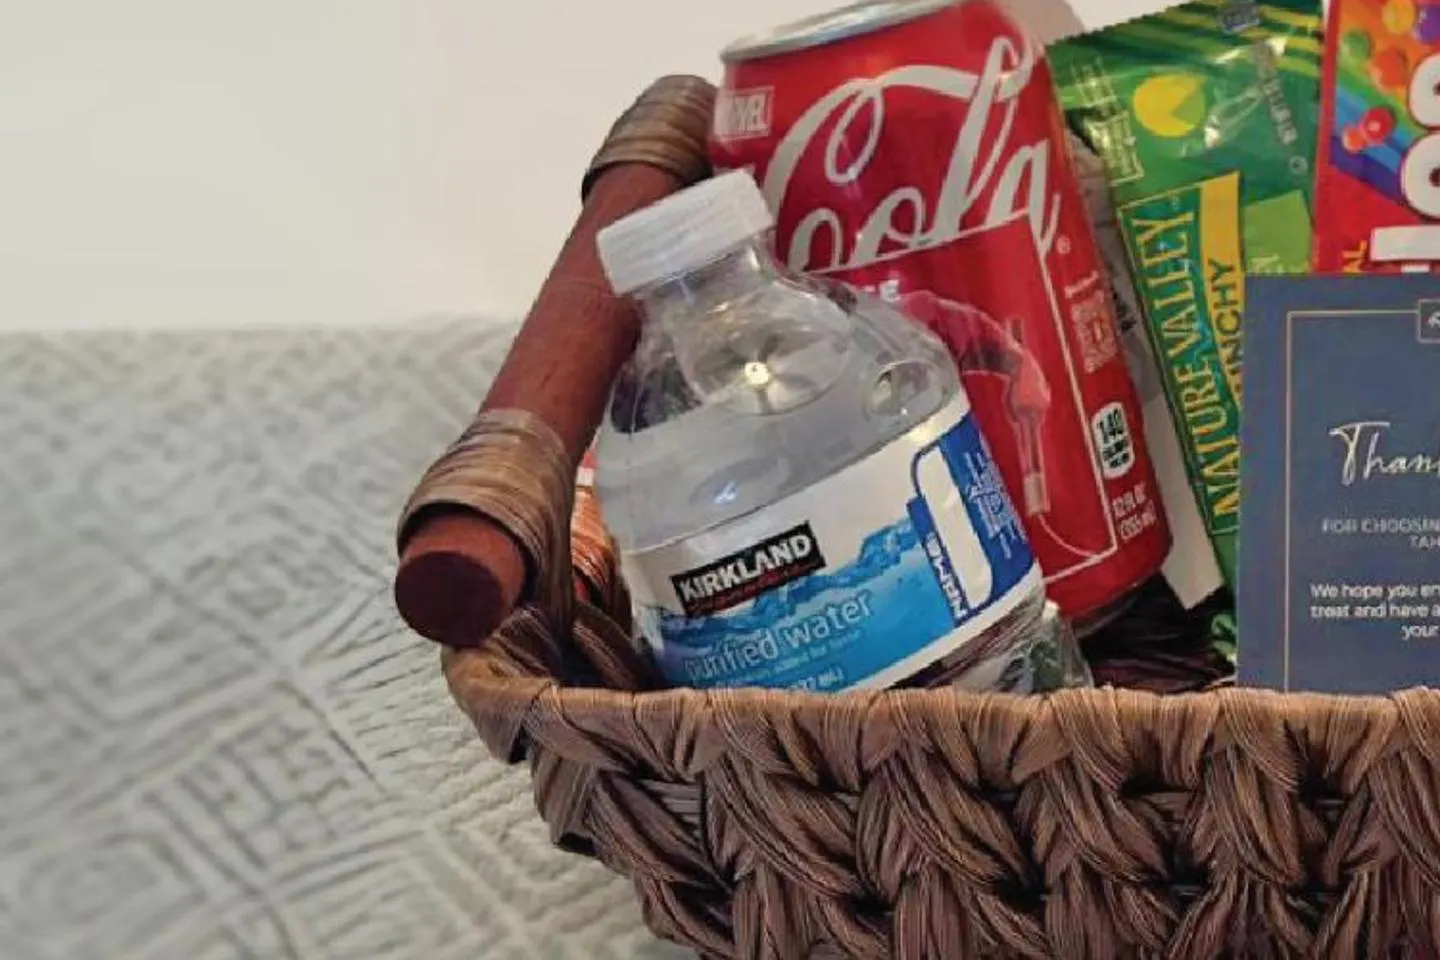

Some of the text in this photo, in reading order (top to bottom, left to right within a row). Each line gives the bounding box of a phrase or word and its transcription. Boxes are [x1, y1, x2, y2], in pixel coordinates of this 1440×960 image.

[1132, 208, 1240, 517] NATURE VALLEY
[1321, 518, 1357, 534] FOR
[677, 533, 813, 603] KIRKLAND
[1309, 583, 1339, 599] We
[1342, 583, 1384, 601] hope
[1386, 586, 1418, 601] you
[1309, 603, 1350, 618] treat
[1353, 603, 1388, 618] and
[1389, 601, 1430, 618] have
[782, 592, 874, 649] water
[1400, 625, 1440, 641] your
